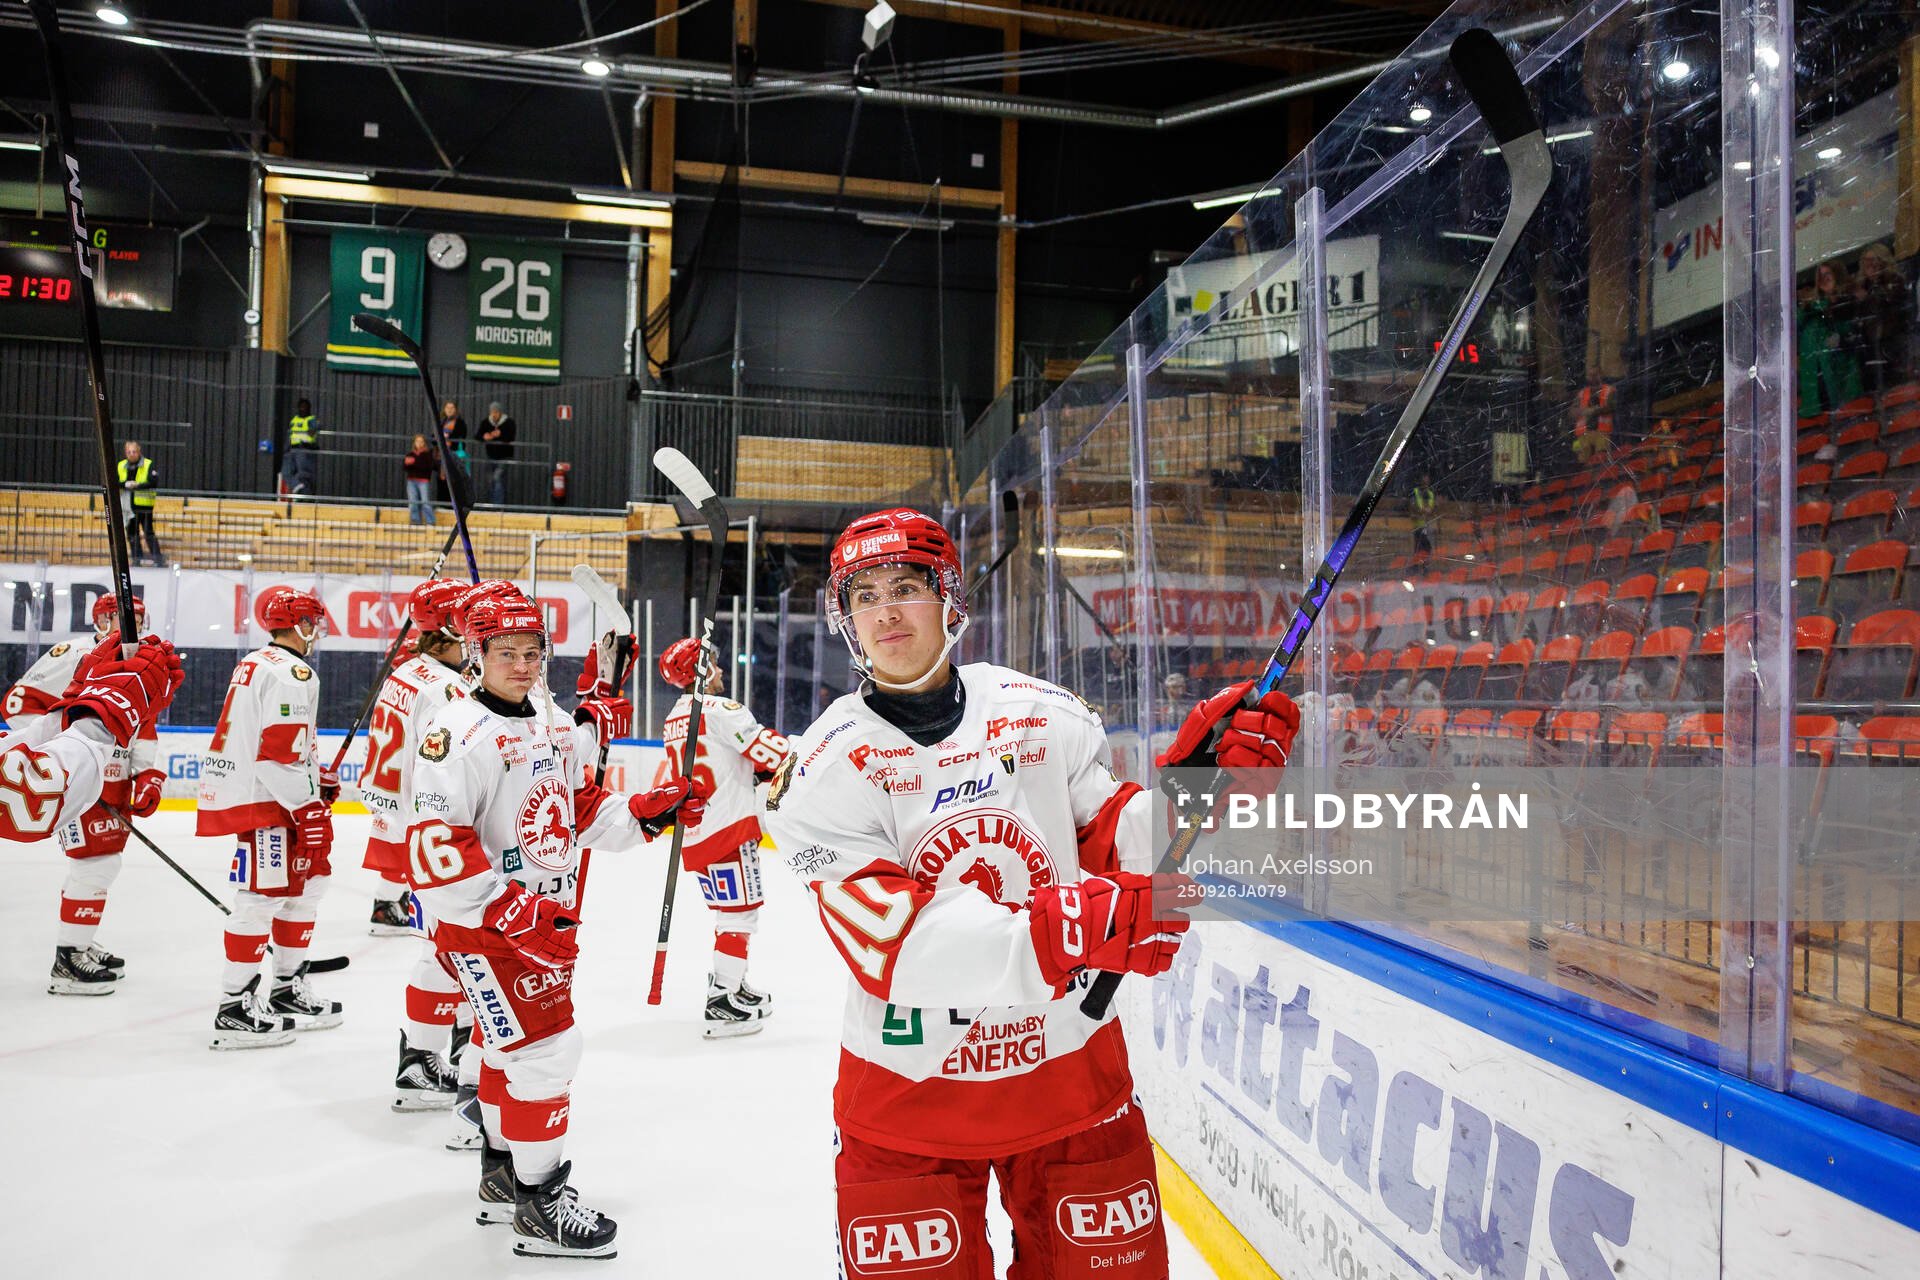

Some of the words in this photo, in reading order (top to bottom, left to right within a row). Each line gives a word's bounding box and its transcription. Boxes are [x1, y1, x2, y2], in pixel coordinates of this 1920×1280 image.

[360, 246, 396, 310] 9
[480, 257, 551, 321] 26
[475, 325, 552, 347] NORDSTRÖM
[861, 533, 900, 548] SVENSKA
[862, 545, 882, 556] SPEL
[79, 686, 140, 727] CCM
[1011, 683, 1074, 702] INTERSPORT
[205, 756, 236, 771] OYOTA
[749, 729, 790, 770] 96
[803, 719, 857, 767] INTERSPORT
[938, 751, 979, 768] CCM
[1020, 747, 1046, 763] etall
[930, 771, 993, 814] pmu
[68, 820, 80, 844] USS
[270, 834, 281, 868] BUSS
[537, 845, 557, 858] 1948
[409, 825, 465, 885] 16
[916, 818, 1053, 894] ROJA-LJUNGB
[495, 888, 534, 932] CCM
[819, 878, 915, 982] 10
[480, 989, 514, 1039] BUSS
[981, 1013, 1047, 1042] LJUNGBY
[942, 1033, 1047, 1076] ENERGI
[1066, 1188, 1154, 1238] EAB
[852, 1216, 954, 1266] EAB
[1091, 1255, 1114, 1269] Det
